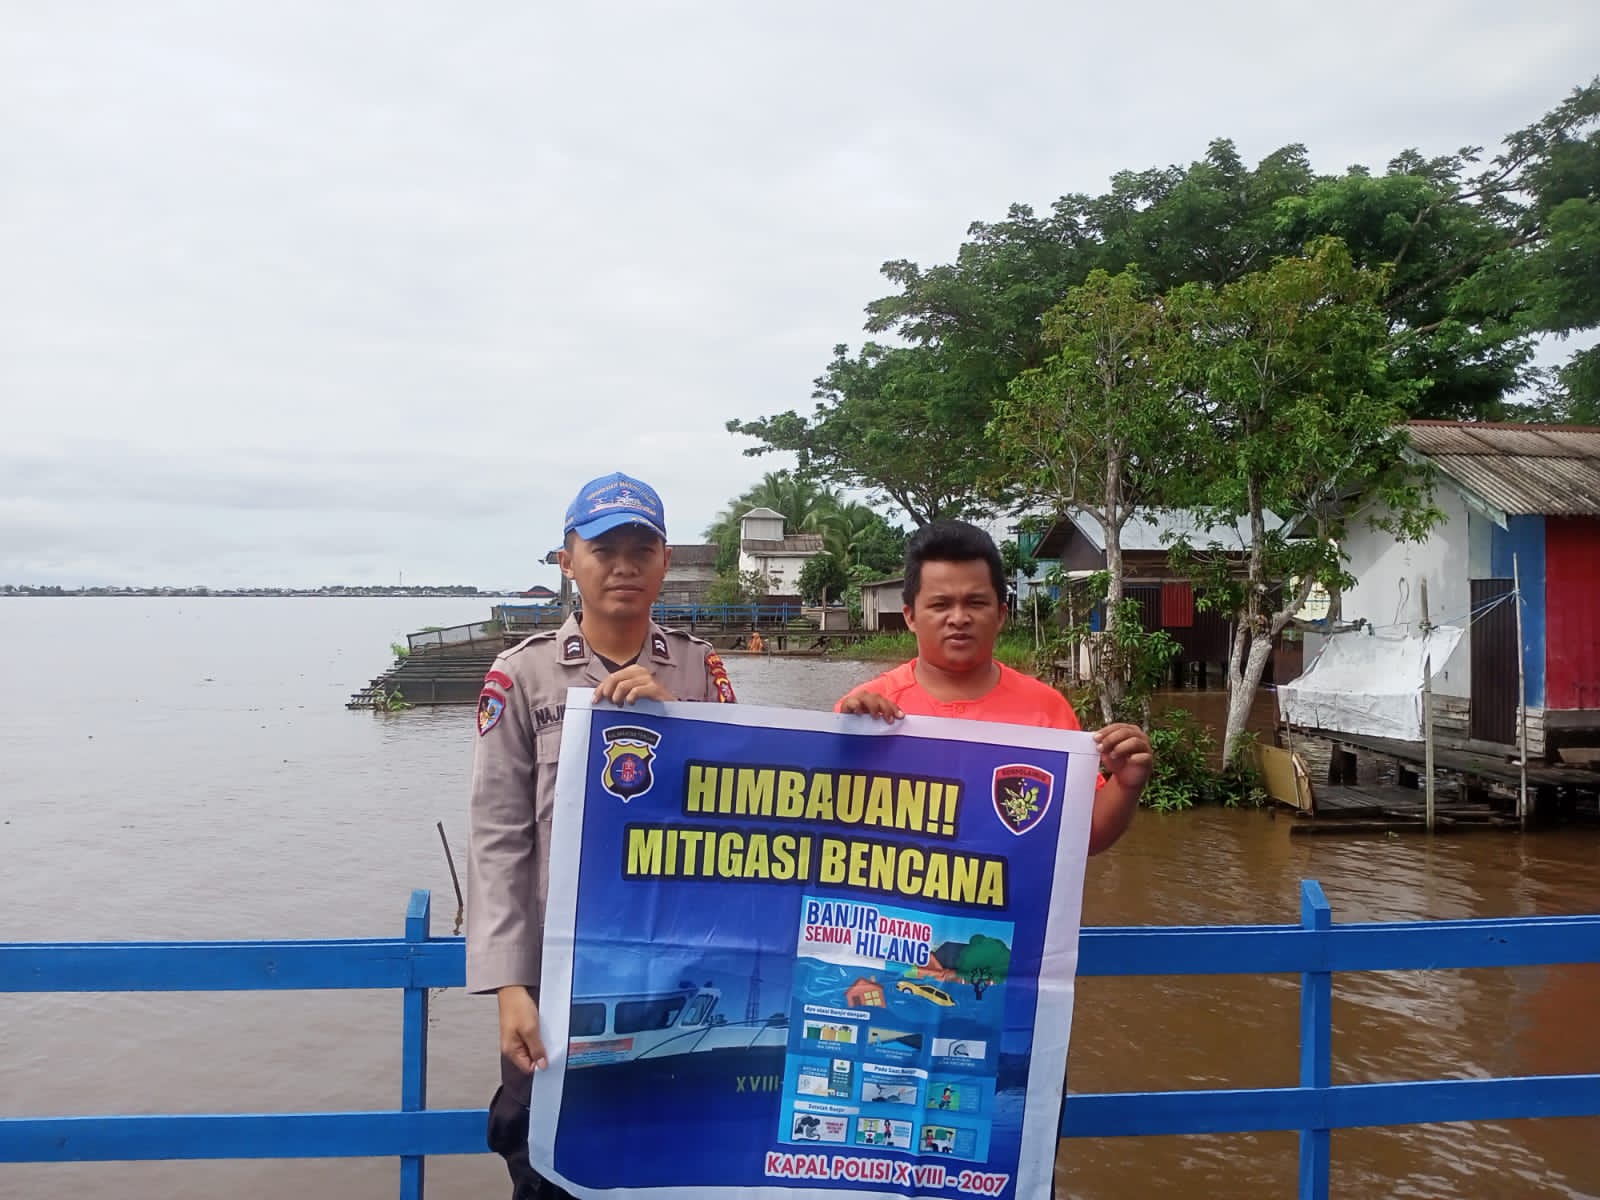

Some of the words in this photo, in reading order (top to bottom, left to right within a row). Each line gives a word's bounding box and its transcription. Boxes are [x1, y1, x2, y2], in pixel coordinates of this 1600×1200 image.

[687, 765, 960, 834] HIMBAUAN!!
[626, 828, 811, 881] MITIGASI
[819, 838, 1005, 906] BENCANA
[807, 901, 878, 932] BANJIR
[879, 917, 931, 942] DATANG
[805, 925, 852, 945] SEMUA
[855, 931, 930, 965] HILANG
[766, 1154, 829, 1177] KAPAL
[833, 1160, 891, 1180] POLISI
[961, 1172, 1007, 1194] 2007
